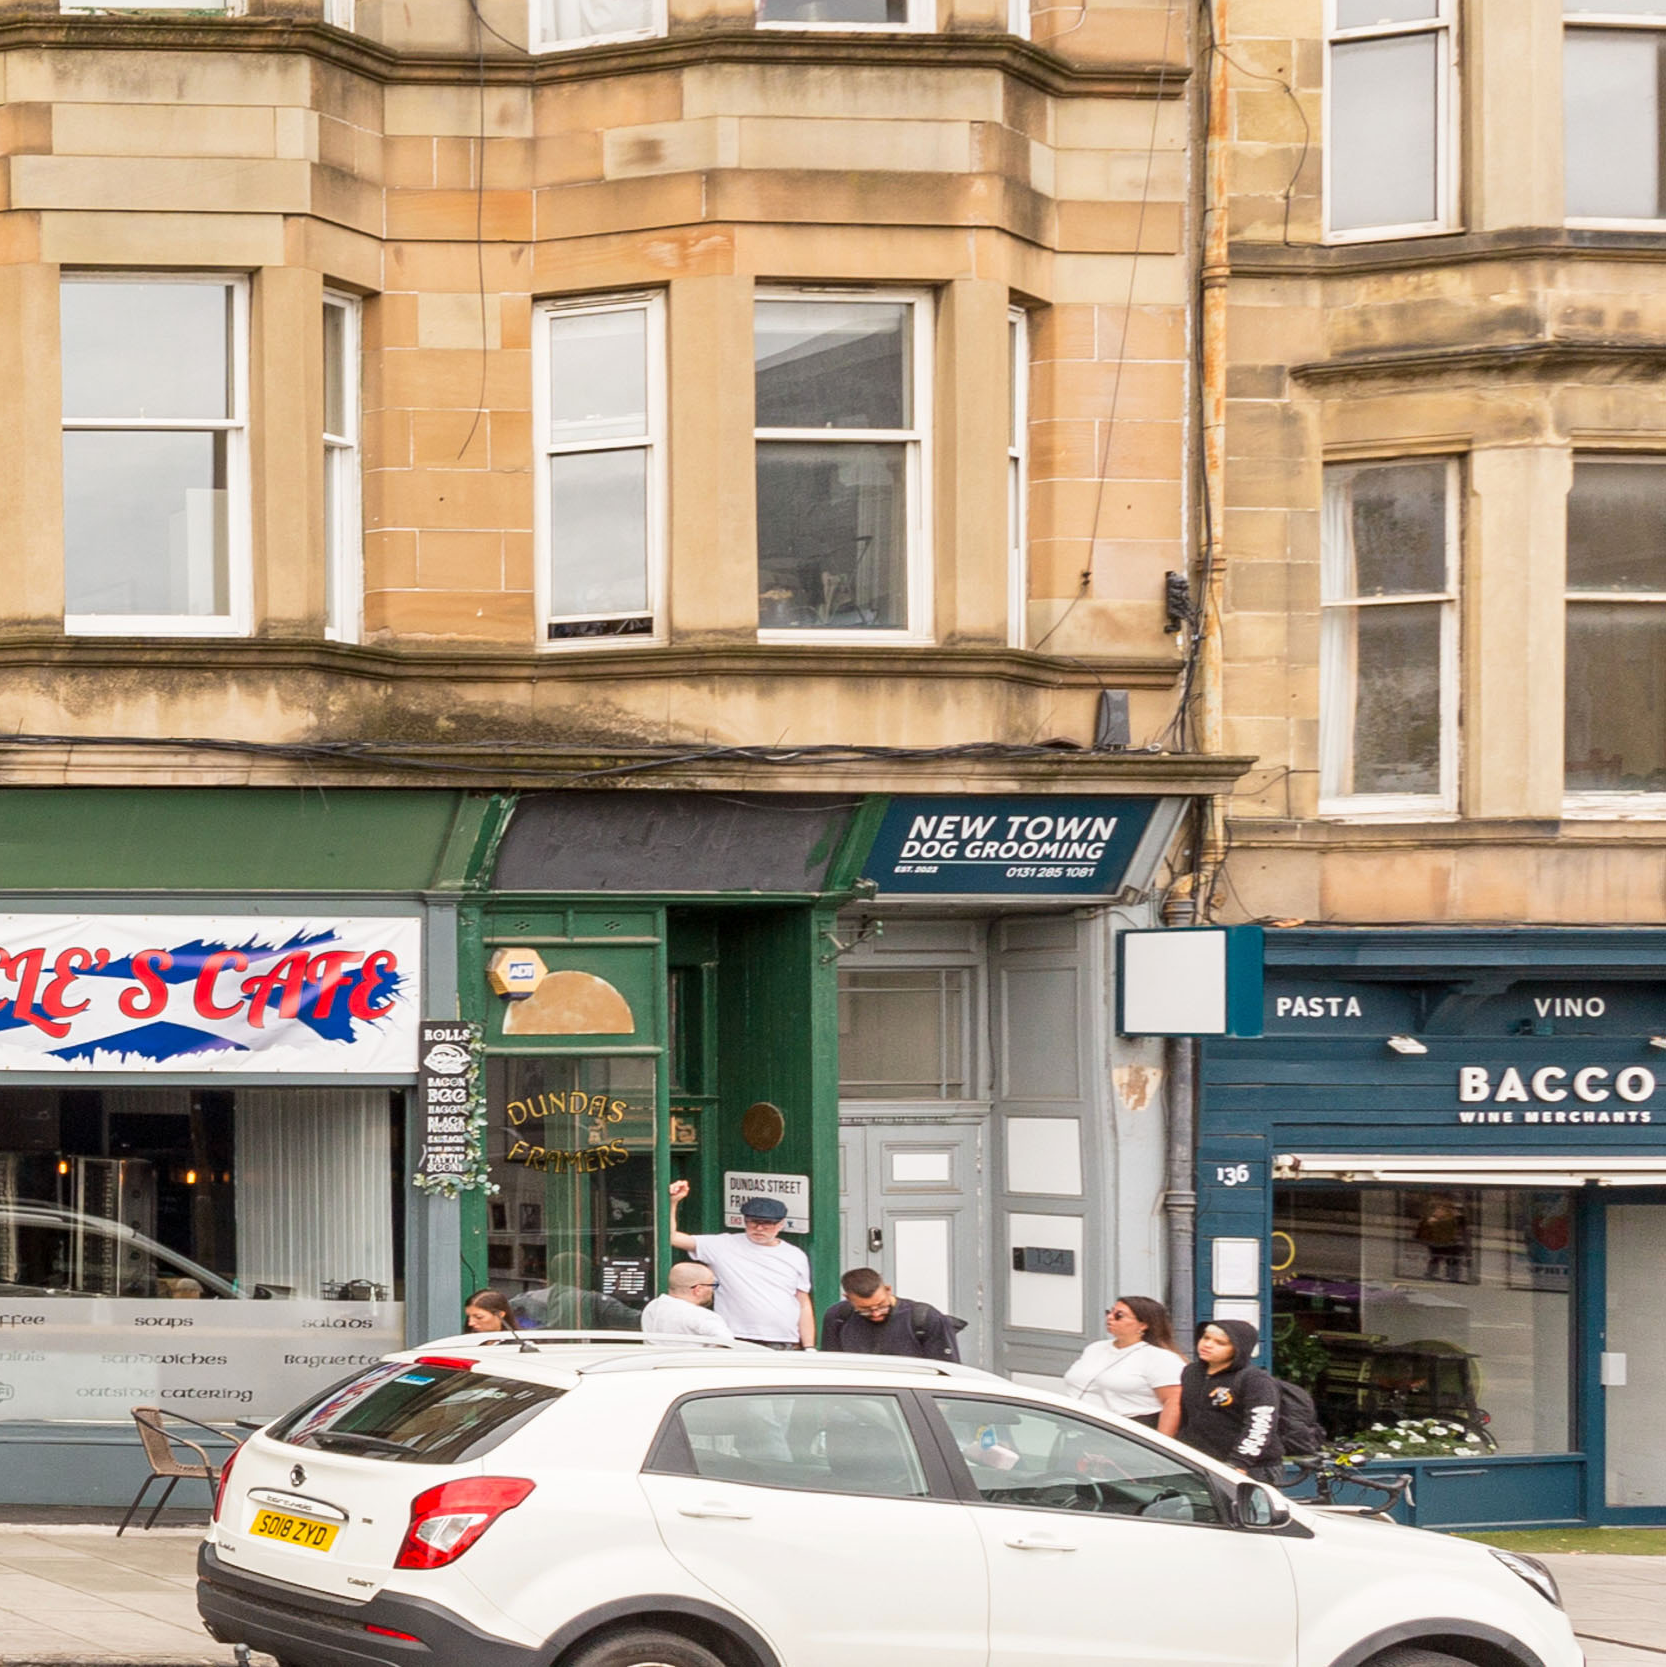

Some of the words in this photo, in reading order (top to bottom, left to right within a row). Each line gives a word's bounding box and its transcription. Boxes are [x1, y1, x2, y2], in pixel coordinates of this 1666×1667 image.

[908, 816, 997, 840] NEW
[1006, 816, 1118, 841] TOWN
[900, 841, 959, 858] DOG
[964, 841, 1106, 860] GROOMING
[894, 866, 913, 874] EST.
[1006, 867, 1036, 878] 0131
[1036, 868, 1063, 878] 285
[1065, 868, 1096, 878] 1081
[193, 948, 398, 1030] CAFE
[1276, 996, 1362, 1018] PASTA
[1534, 997, 1605, 1018] VINO
[424, 1029, 471, 1042] ROLLS
[427, 1077, 466, 1087] BACON
[1459, 1066, 1655, 1103] BACCO
[427, 1088, 466, 1103] EGG
[428, 1105, 464, 1114] HAGG
[507, 1090, 628, 1126] DUNDAS
[1459, 1111, 1513, 1124] WINE
[1524, 1111, 1652, 1124] MERCHANTS
[507, 1138, 629, 1174] FRAMERS
[1217, 1164, 1250, 1186] 136
[730, 1177, 765, 1192] DUNDAS
[767, 1179, 801, 1194] STREET
[1034, 1250, 1065, 1266] 134
[135, 1316, 193, 1328] soups
[302, 1317, 373, 1329] salads
[101, 1352, 227, 1365] sandwiches
[76, 1387, 156, 1398] outside
[160, 1387, 253, 1402] catering
[293, 1522, 328, 1546] ZYD
